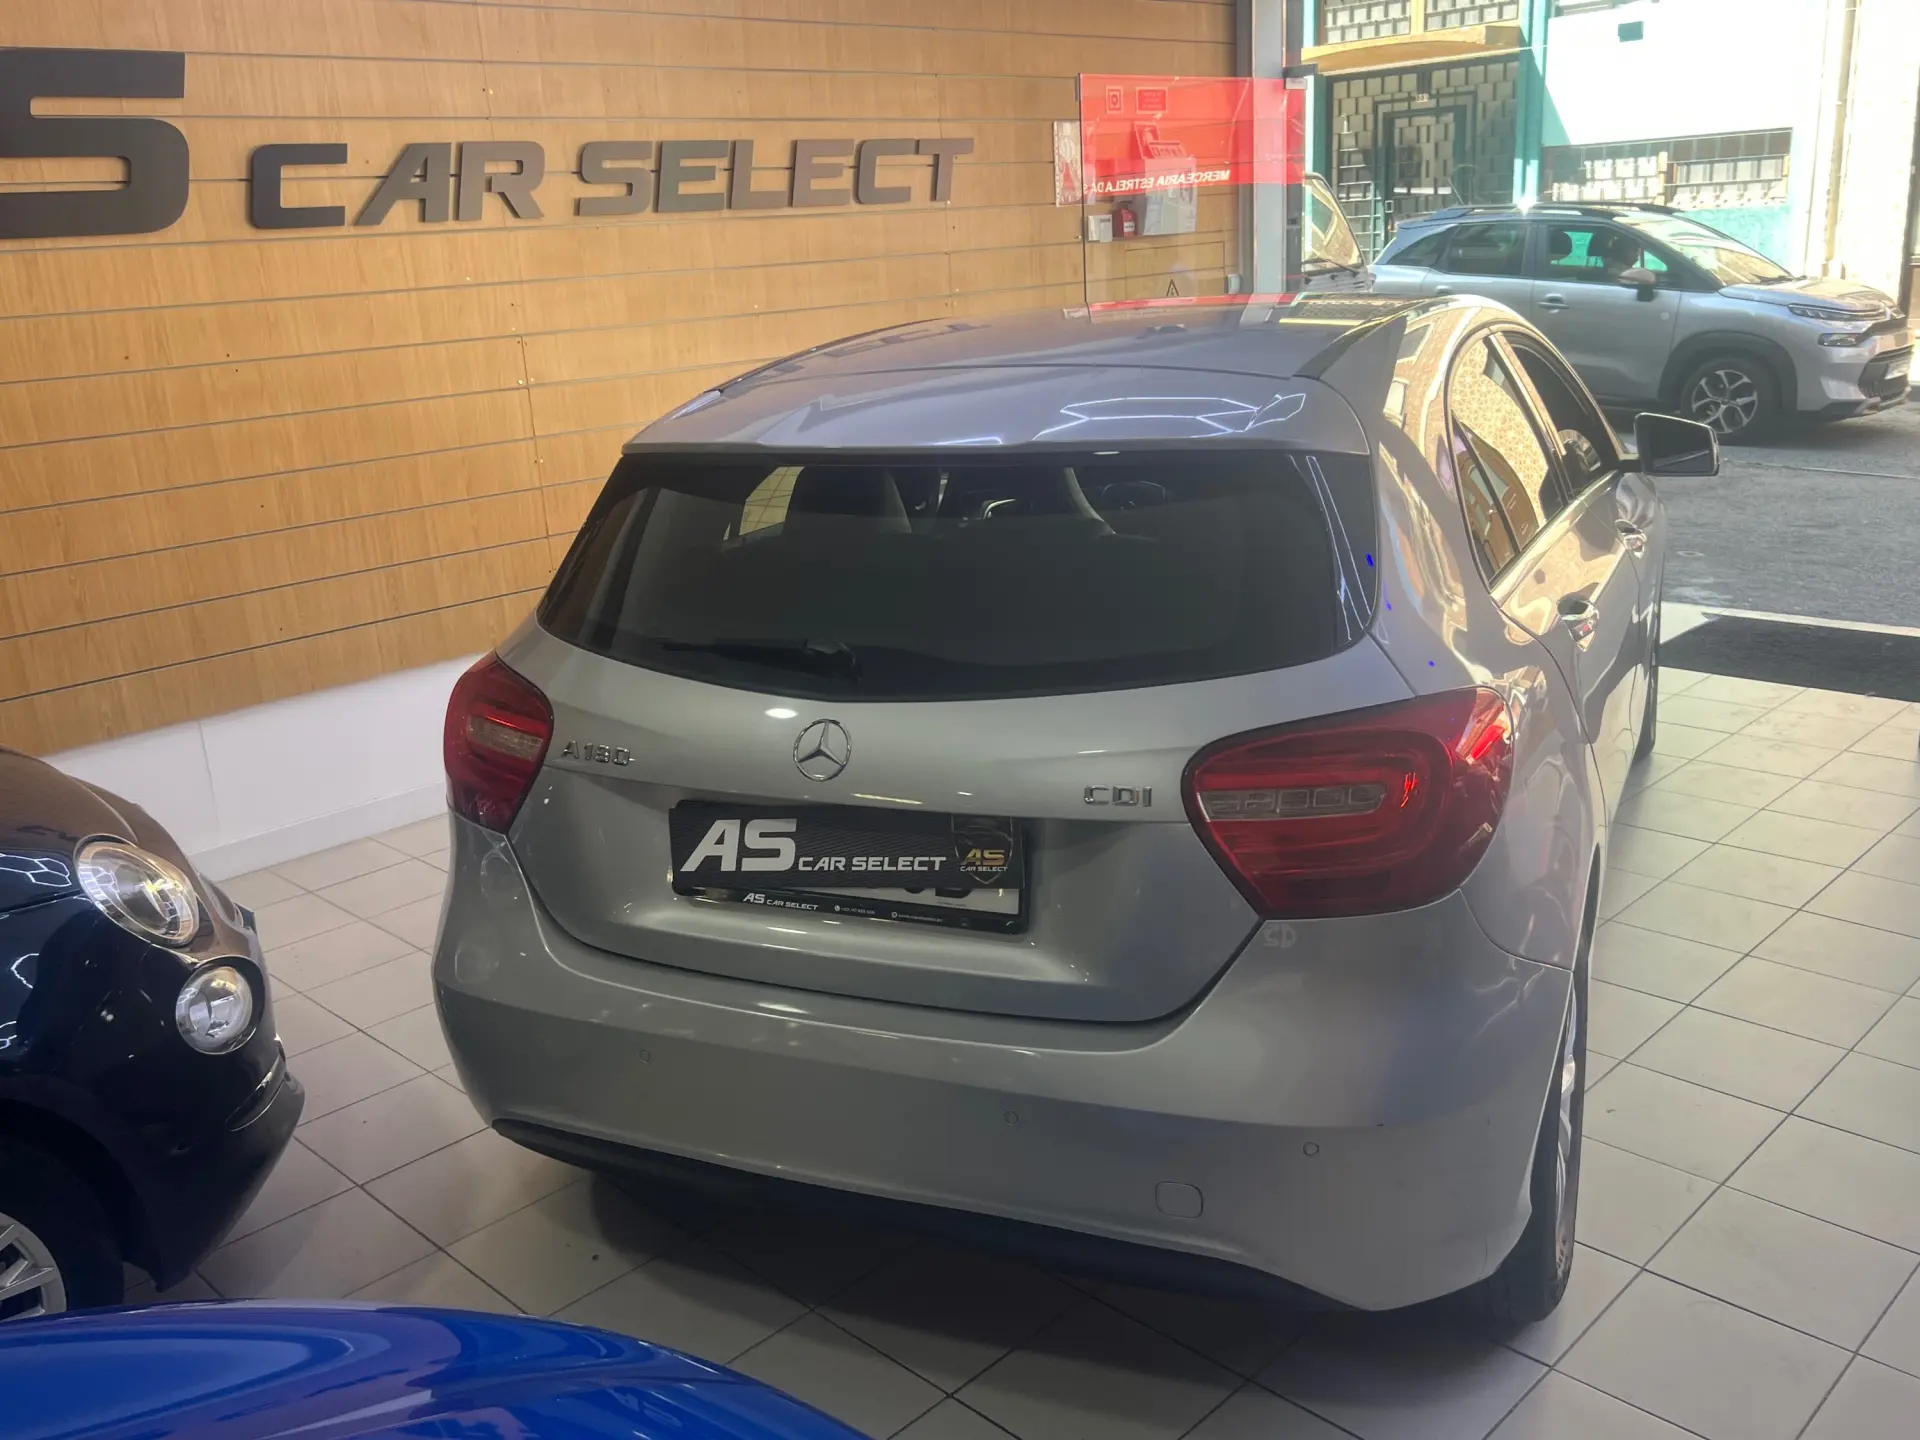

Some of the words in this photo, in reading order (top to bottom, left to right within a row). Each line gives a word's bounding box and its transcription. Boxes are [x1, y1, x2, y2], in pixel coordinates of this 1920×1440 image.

[251, 141, 545, 229] CAR
[574, 138, 974, 216] SELECT
[1084, 784, 1152, 807] CDI
[680, 818, 797, 872] AS
[798, 857, 845, 871] CAR
[851, 857, 946, 871] SELECT
[961, 848, 1005, 866] AS
[743, 892, 765, 904] AS
[785, 901, 818, 911] SELECT
